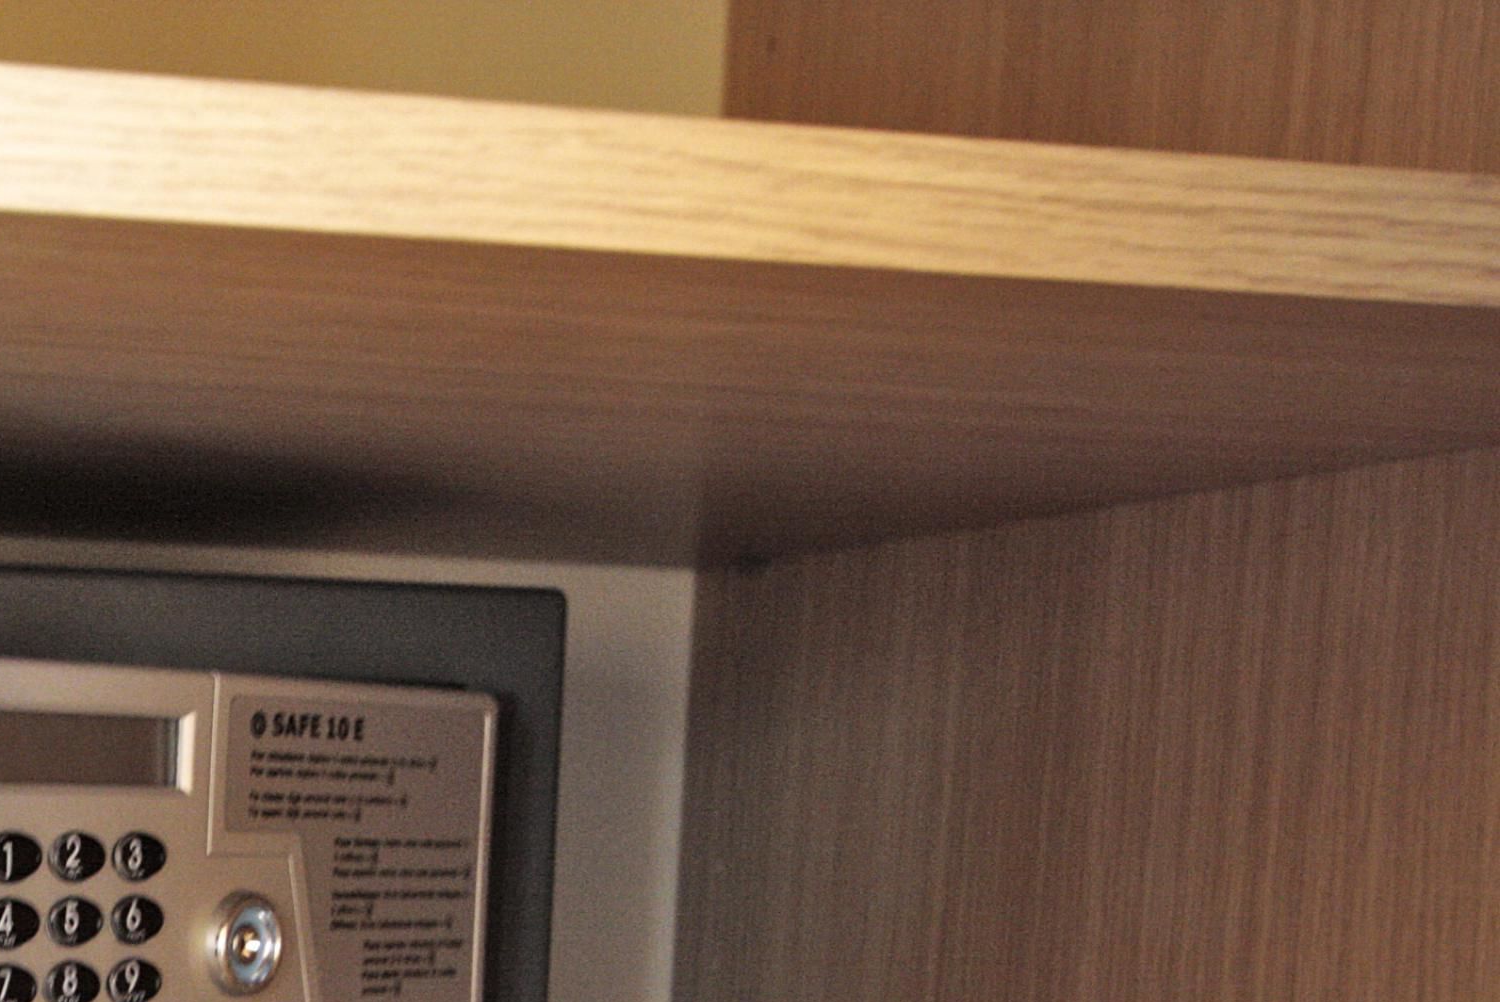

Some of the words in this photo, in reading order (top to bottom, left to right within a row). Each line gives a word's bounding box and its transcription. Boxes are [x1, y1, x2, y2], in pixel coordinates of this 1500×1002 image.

[272, 711, 321, 738] SAFE
[326, 716, 349, 741] 10
[353, 716, 365, 742] E
[3, 841, 13, 880] 1
[66, 834, 81, 868] 2
[128, 838, 142, 870] 3
[64, 900, 79, 935] 5
[126, 899, 141, 931] 6
[0, 968, 12, 1000] 7
[63, 964, 78, 996] 8
[125, 960, 140, 994] 9
